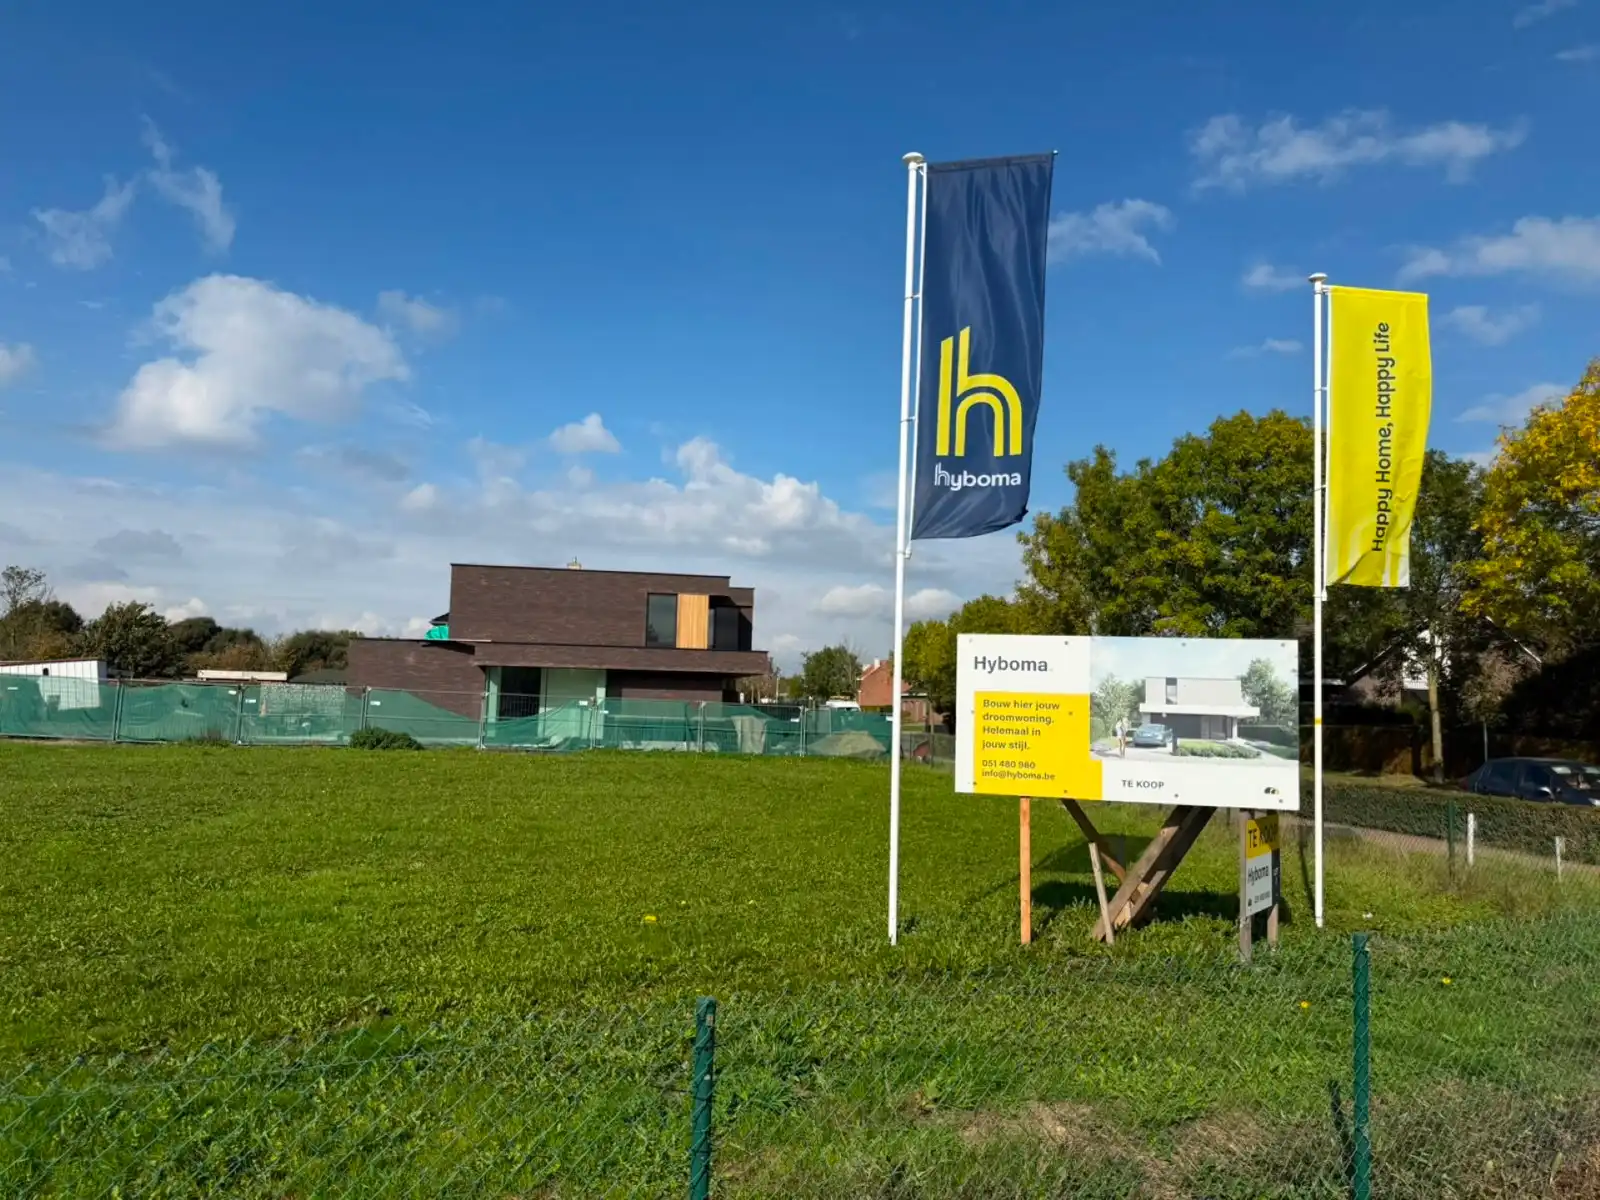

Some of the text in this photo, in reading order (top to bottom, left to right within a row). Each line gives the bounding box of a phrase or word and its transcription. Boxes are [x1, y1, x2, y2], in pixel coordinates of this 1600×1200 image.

[1371, 321, 1396, 552] Happy Home, Happy Life
[934, 462, 1022, 491] hyboma
[973, 655, 1049, 674] Hyboma
[982, 699, 1060, 712] Bouw hier jouw
[982, 712, 1055, 726] droomwoning.
[982, 726, 1041, 737] Helemaal in
[982, 739, 1031, 752] jouw stijl.
[982, 759, 997, 768] 051
[999, 760, 1016, 769] 480
[981, 769, 1056, 781] info@hyboma.be
[1122, 779, 1165, 790] TE KOOP
[1248, 828, 1258, 849] TE
